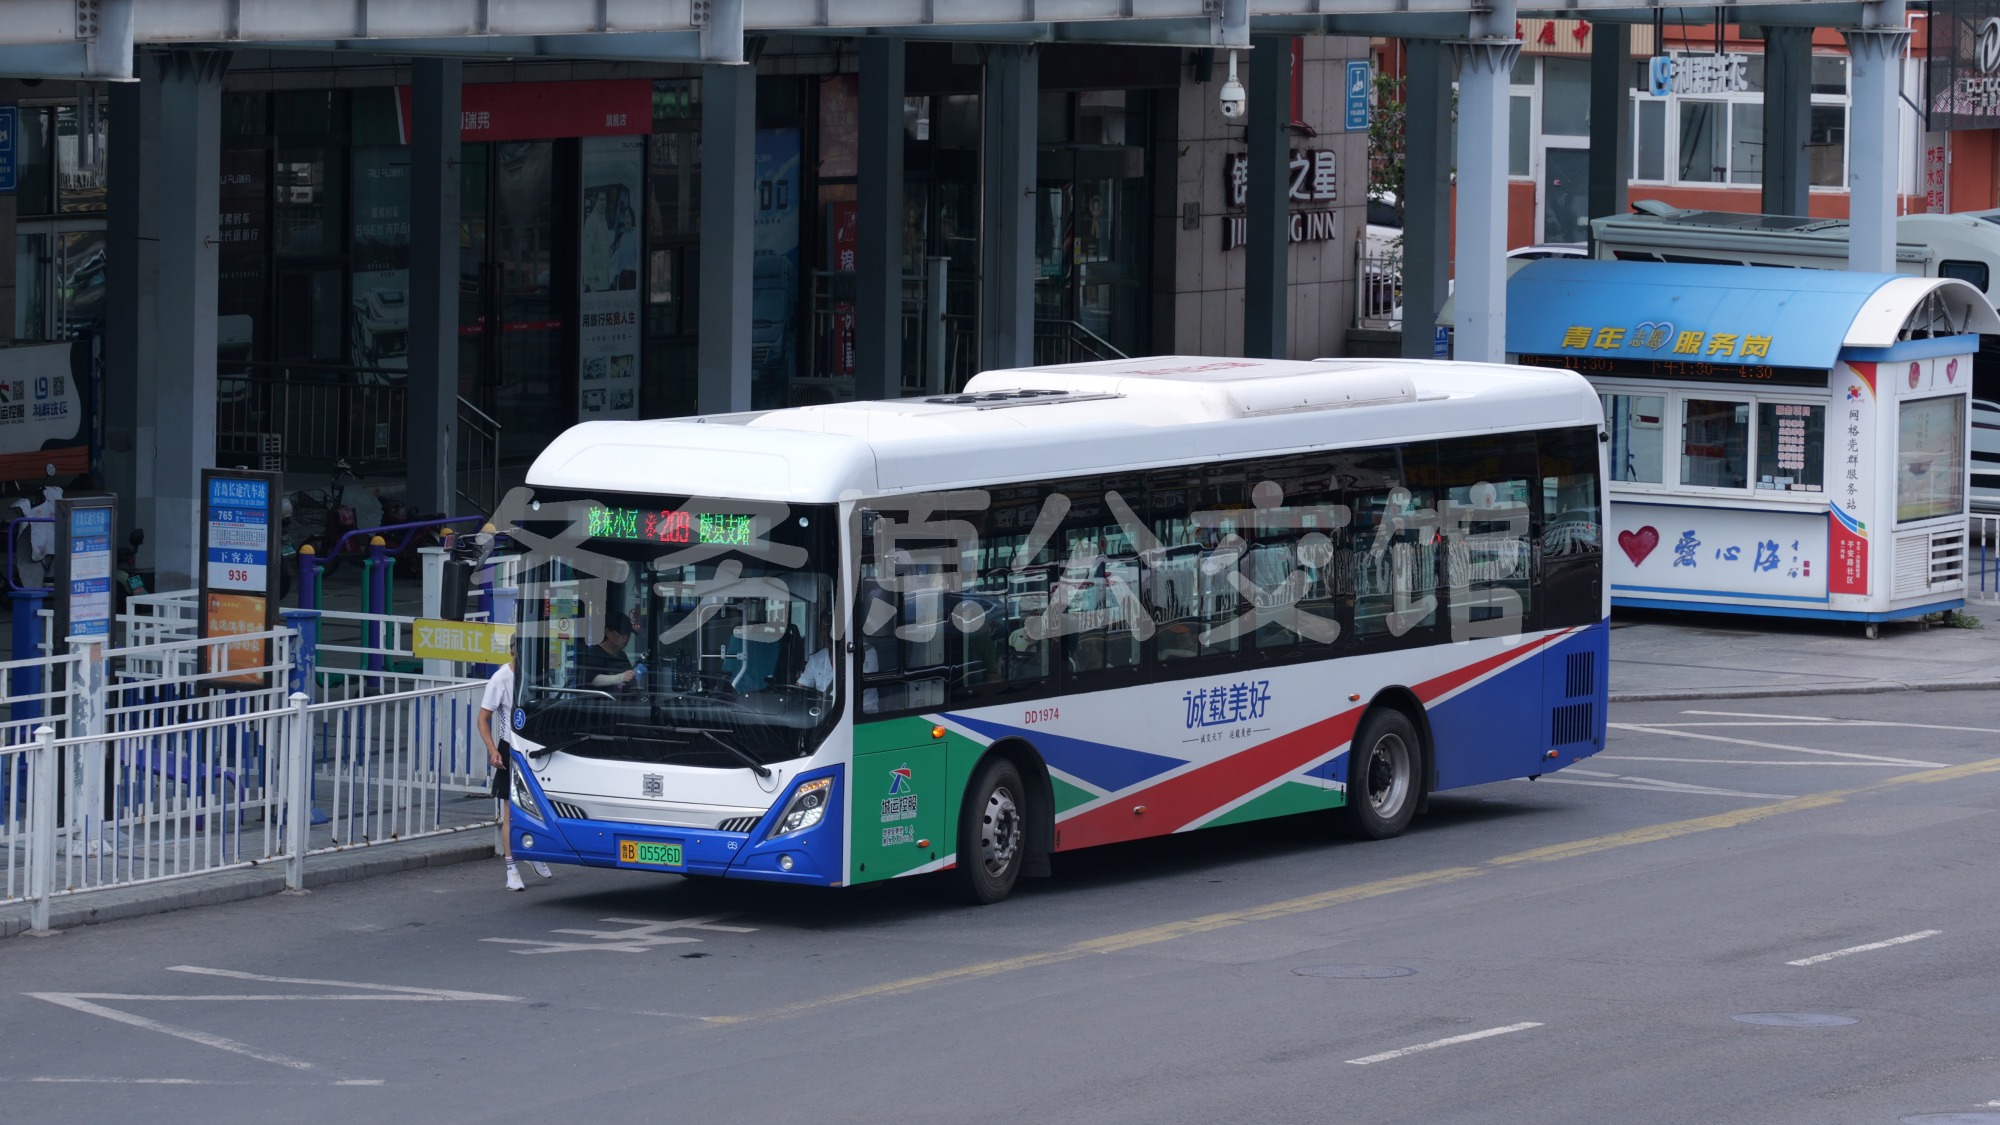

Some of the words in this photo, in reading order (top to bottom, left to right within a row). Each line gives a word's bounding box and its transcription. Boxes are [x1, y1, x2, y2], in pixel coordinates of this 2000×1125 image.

[1674, 53, 1748, 94] 利群洗衣
[605, 113, 628, 127] 旗舰店
[1232, 151, 1337, 204] 锦之星
[1307, 212, 1337, 241] INN
[582, 311, 636, 328] 用旅行拓宽人生
[1846, 409, 1860, 510] 网格党群服务站
[214, 481, 267, 499] 青岛长途汽车站
[218, 510, 233, 521] 765
[588, 506, 639, 539] 洛东小区
[660, 510, 691, 543] 209
[699, 511, 751, 546] 陵县支路
[75, 541, 84, 551] 20
[219, 551, 254, 564] 下客站
[1846, 540, 1855, 584] 平安路社区
[228, 569, 248, 581] 936
[73, 582, 85, 593] 126
[74, 624, 87, 634] 209
[418, 626, 484, 653] 文明礼让
[1182, 680, 1271, 729] 诚载美好
[1025, 707, 1059, 724] DD1974
[881, 794, 918, 816] 城运控股
